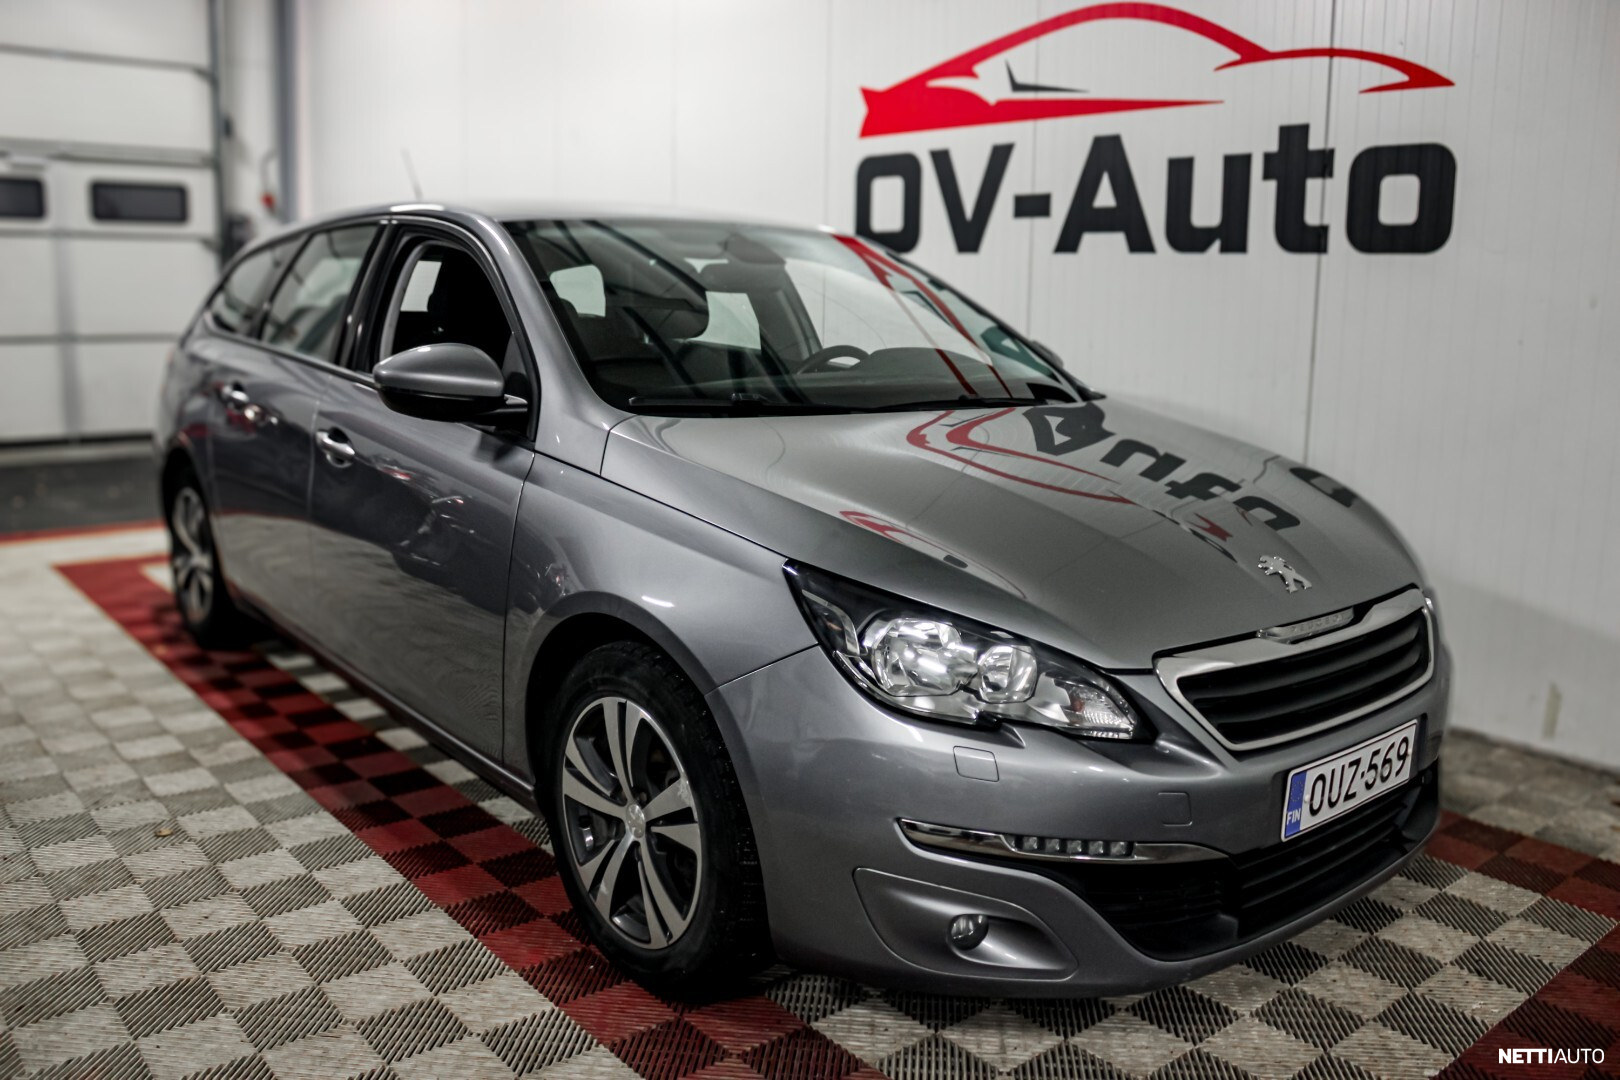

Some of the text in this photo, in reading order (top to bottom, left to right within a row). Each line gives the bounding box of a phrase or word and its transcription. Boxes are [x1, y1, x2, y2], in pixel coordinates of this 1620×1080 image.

[855, 123, 1457, 254] OV-Auto
[1309, 736, 1409, 816] OUZ-569
[1286, 808, 1301, 825] FIN
